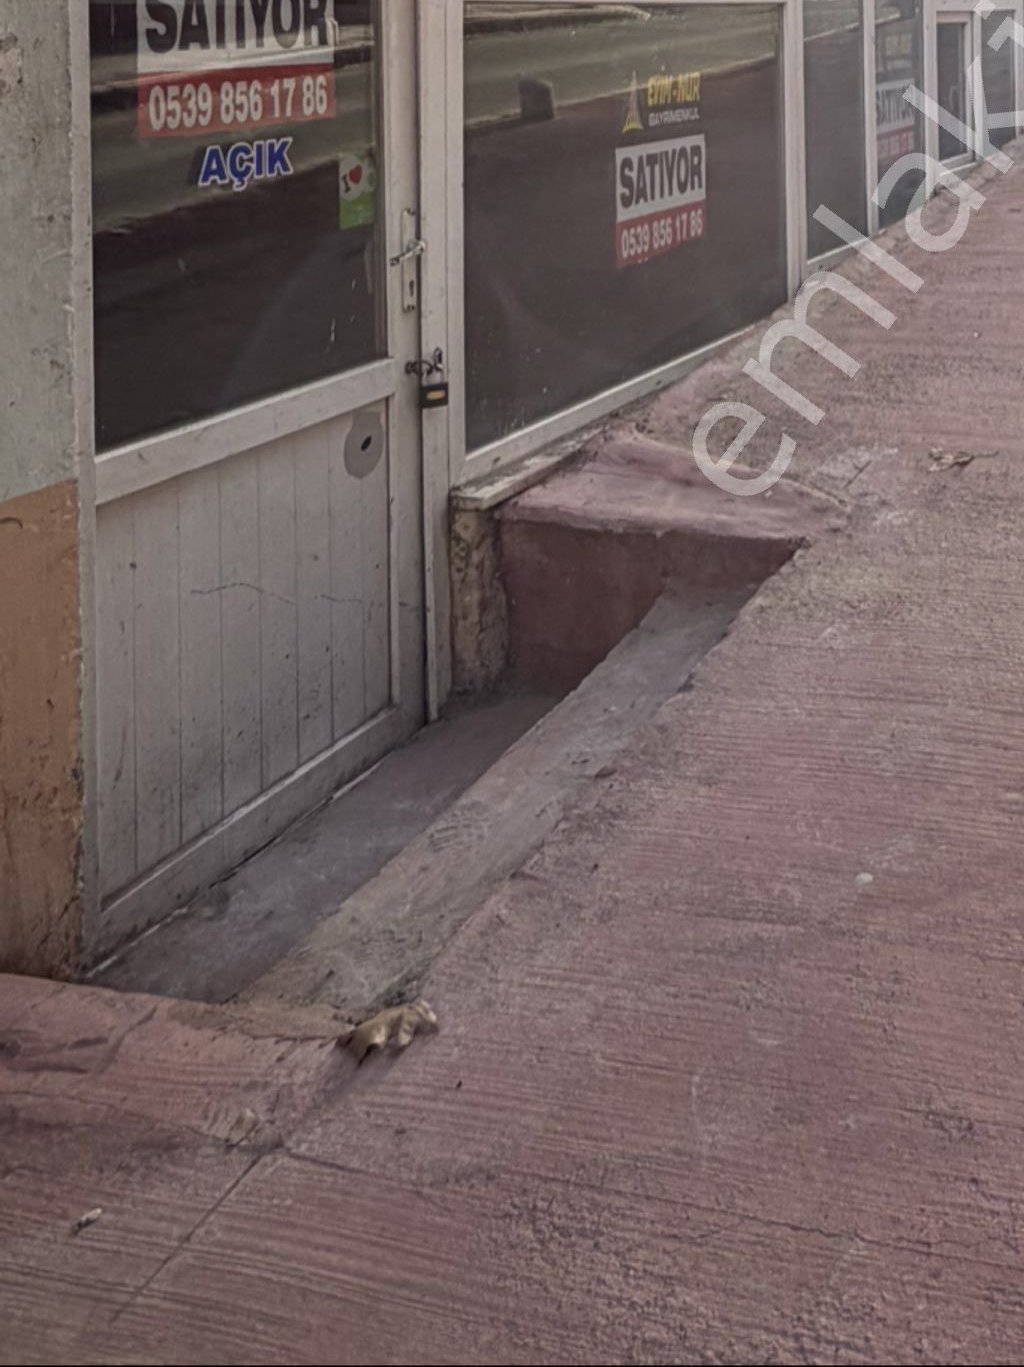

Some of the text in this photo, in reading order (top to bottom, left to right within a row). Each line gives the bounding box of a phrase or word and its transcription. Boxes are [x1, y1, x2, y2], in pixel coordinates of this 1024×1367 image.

[148, 75, 328, 130] 0539 856 17 86
[199, 137, 293, 190] AÇIK
[619, 144, 703, 209] SATIYOR
[621, 222, 650, 259] 0539
[652, 218, 672, 251] 856
[675, 213, 687, 243] 17
